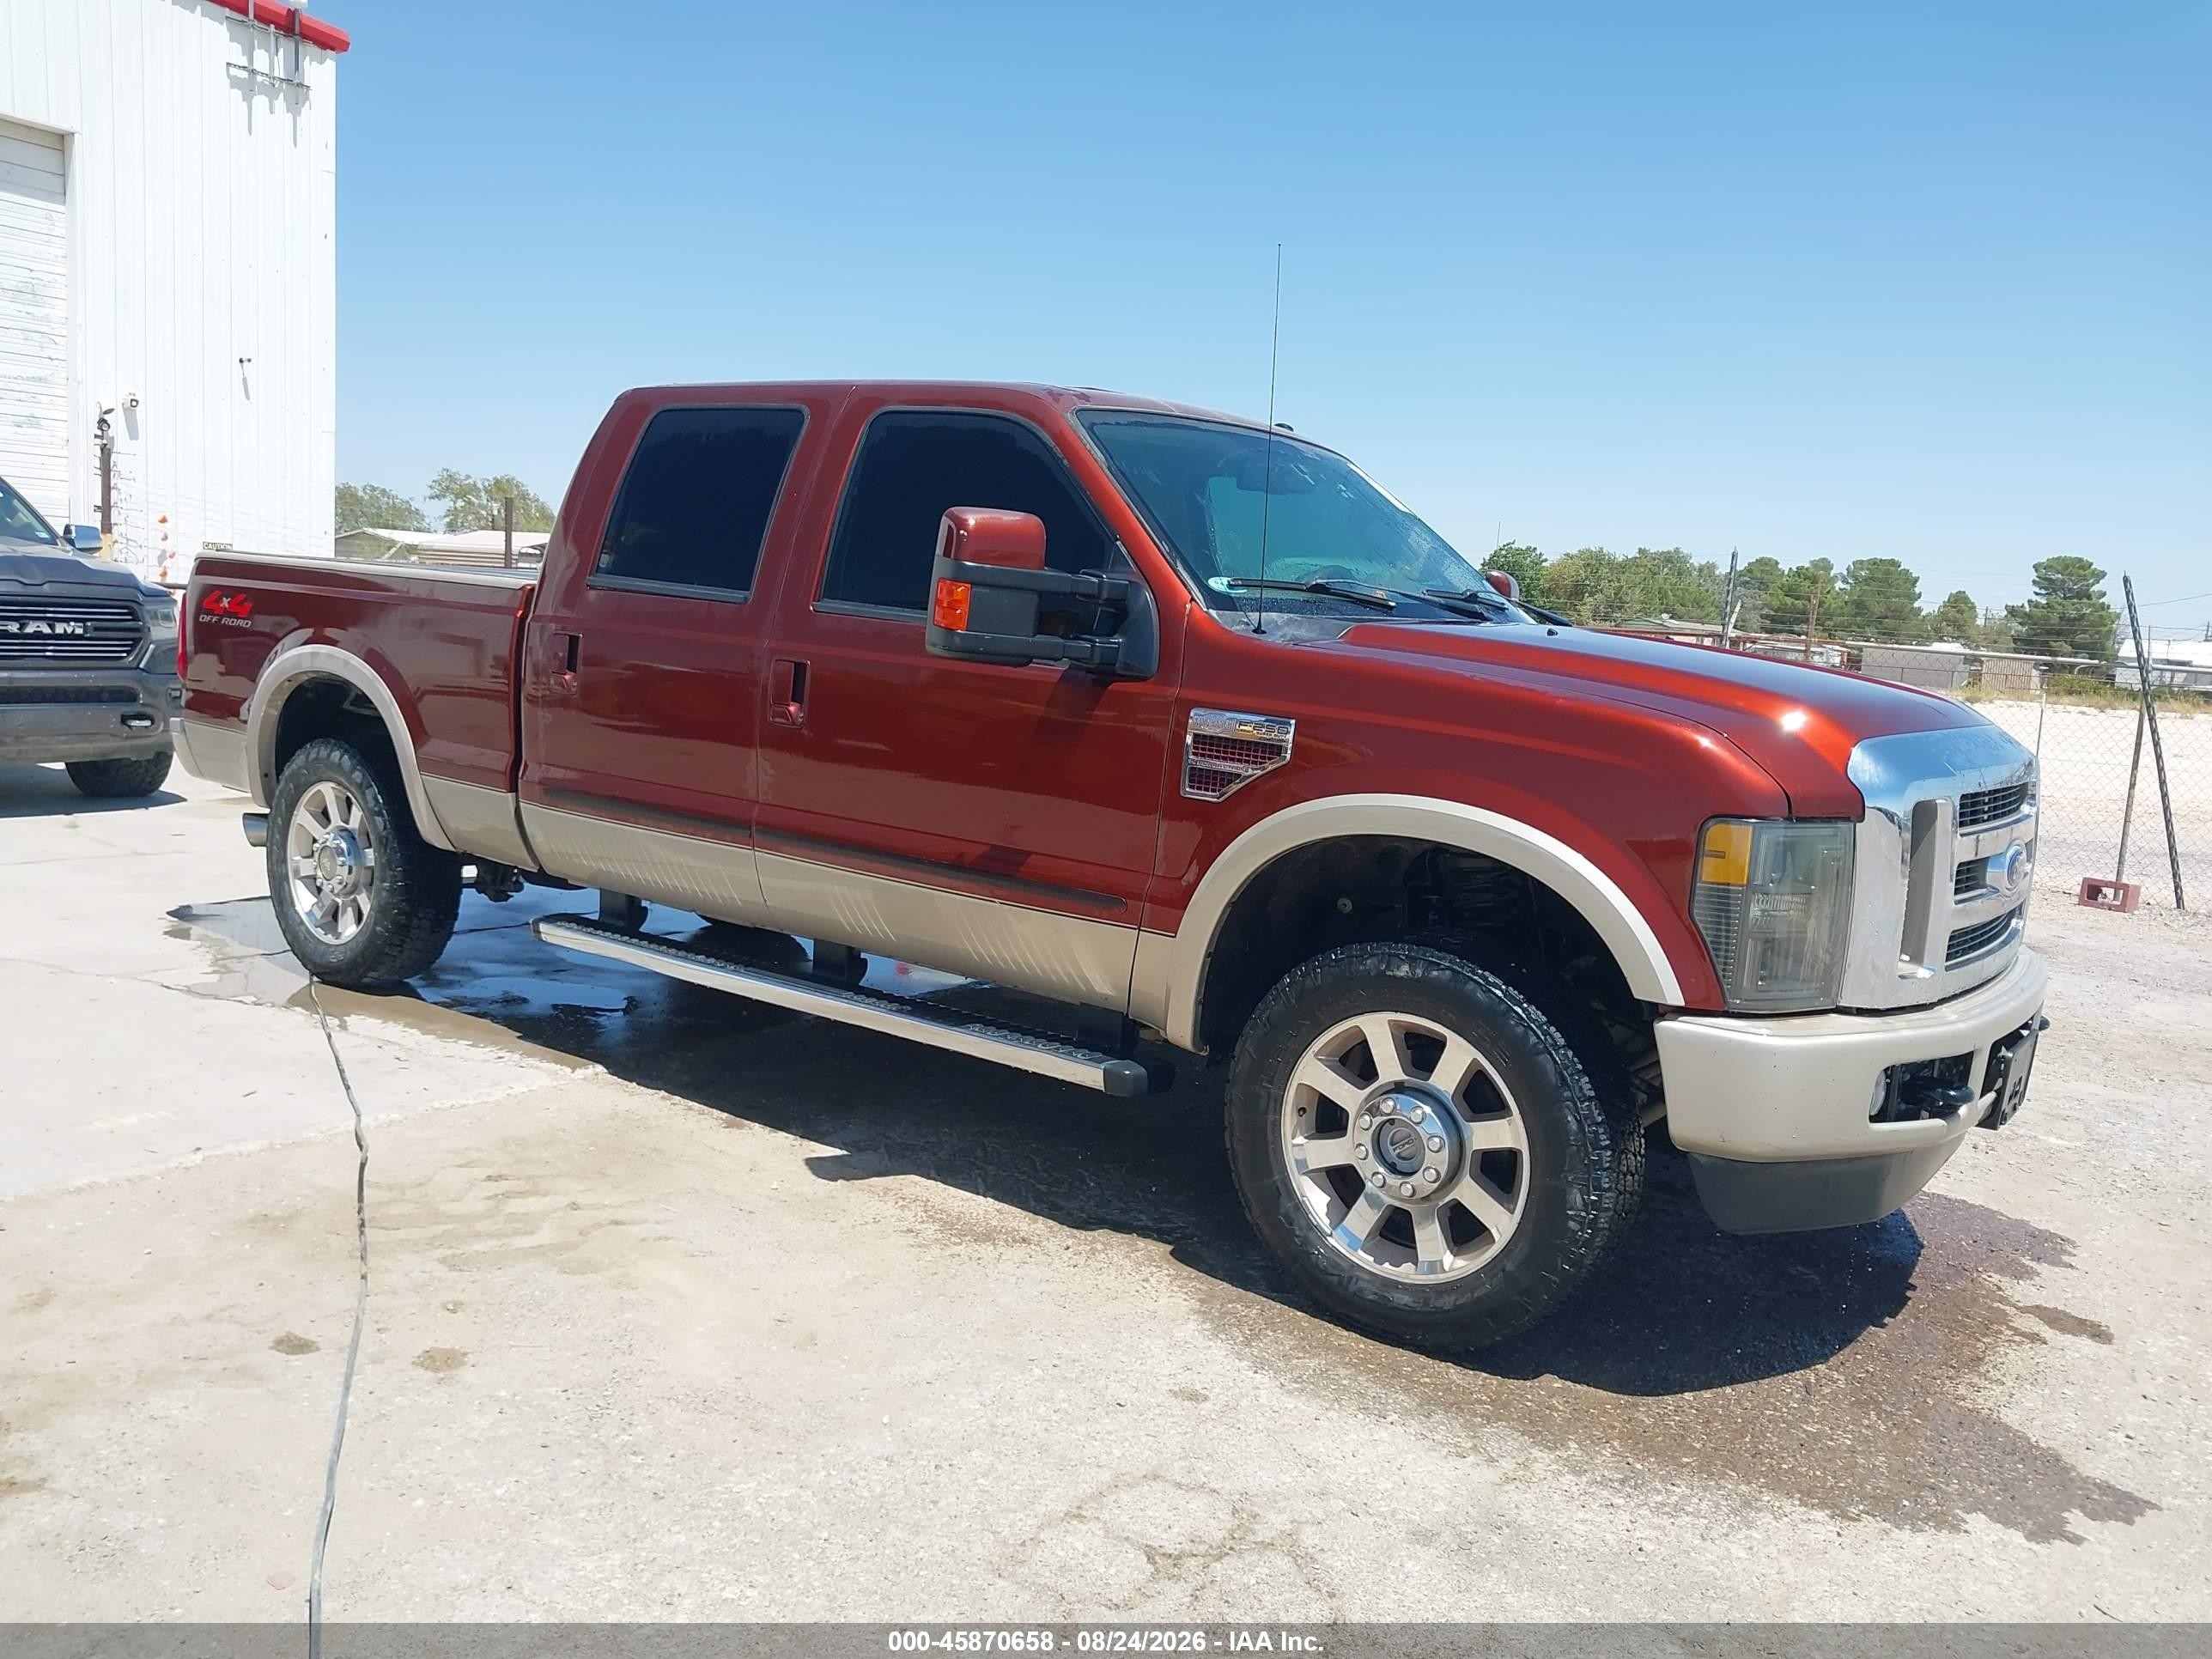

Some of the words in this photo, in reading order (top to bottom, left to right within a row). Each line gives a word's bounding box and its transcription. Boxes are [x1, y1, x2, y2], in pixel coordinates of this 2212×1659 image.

[0, 620, 83, 635] RAM
[199, 614, 220, 623] OFF
[222, 617, 252, 628] ROAD
[1393, 1138, 1414, 1152] FORD
